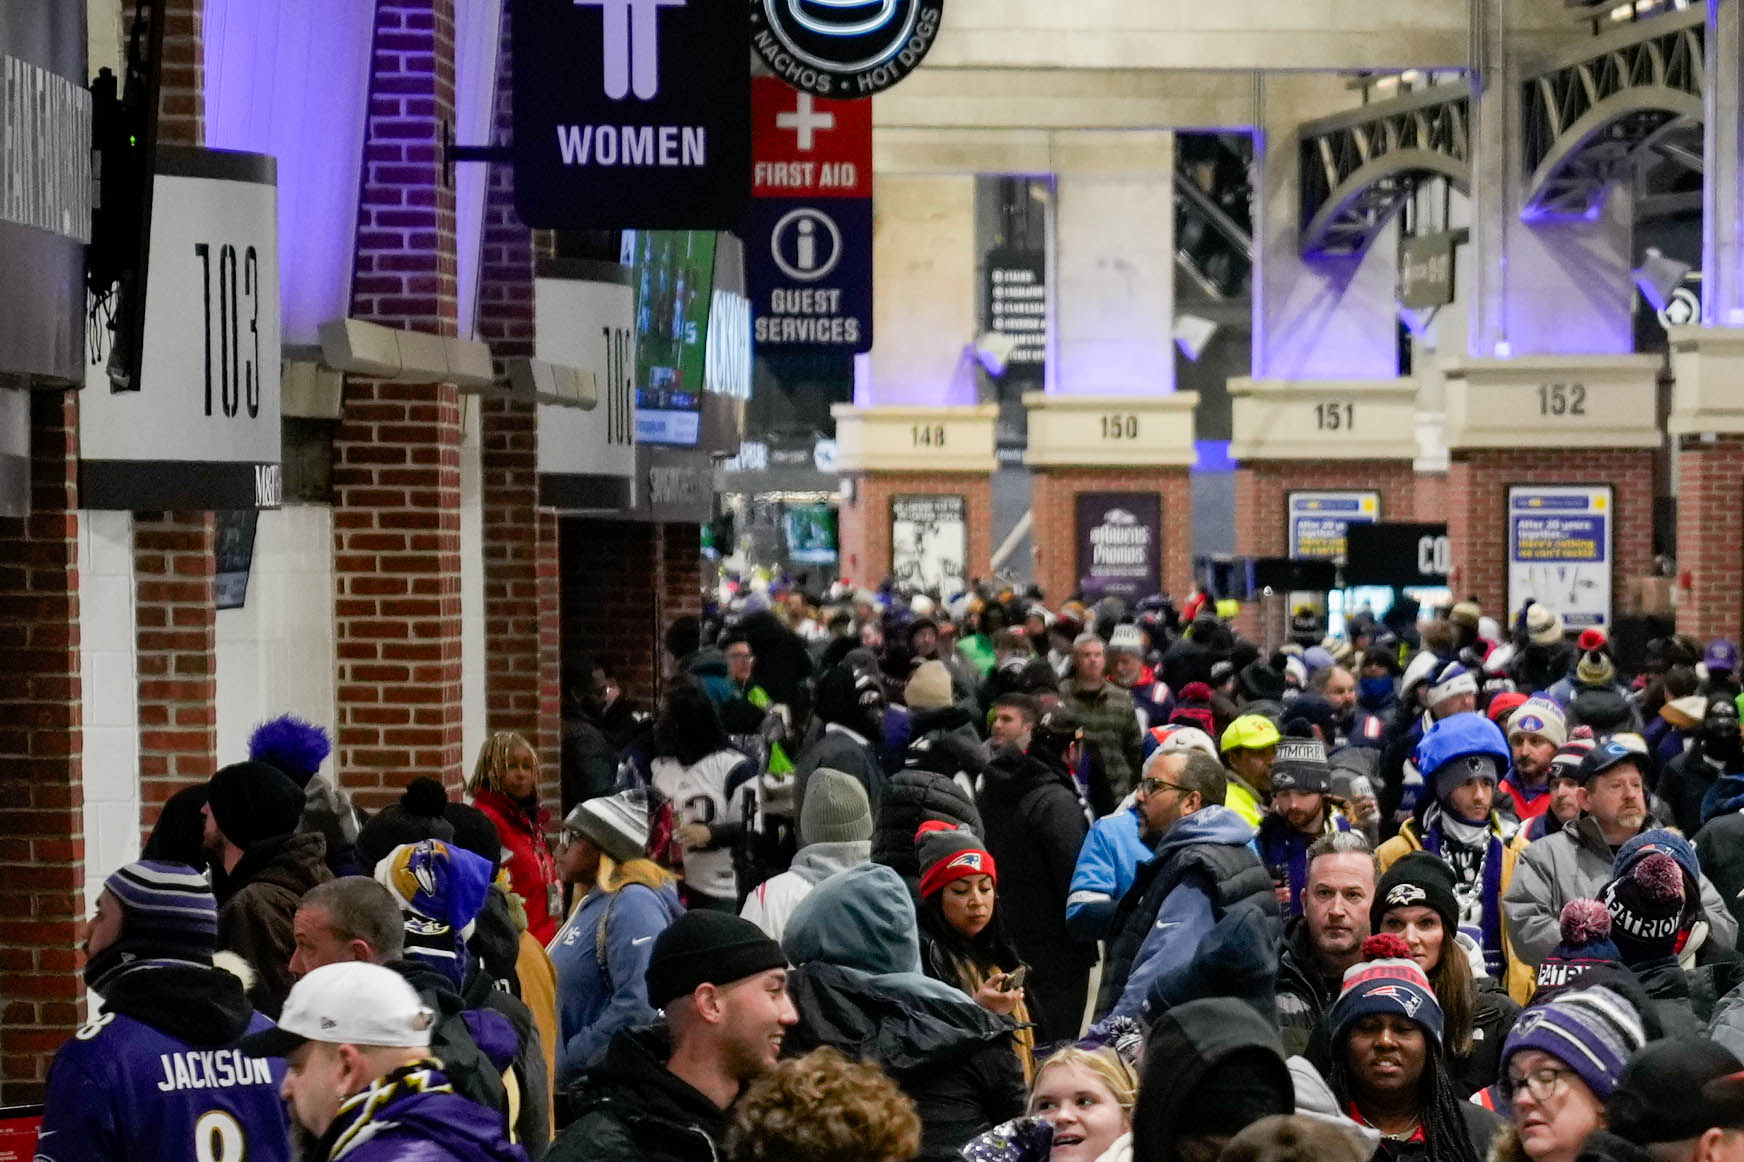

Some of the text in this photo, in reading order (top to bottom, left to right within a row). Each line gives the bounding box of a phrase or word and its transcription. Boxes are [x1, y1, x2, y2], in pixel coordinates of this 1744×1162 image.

[754, 8, 938, 92] NACHOS HOT DOGS
[557, 126, 706, 167] WOMEN
[754, 161, 856, 188] FIRST AID
[771, 288, 841, 314] GUEST
[195, 243, 260, 418] 103
[754, 316, 861, 342] SERVICES
[1537, 383, 1587, 416] 152
[1099, 415, 1138, 440] 150
[1314, 403, 1354, 430] 151
[910, 424, 945, 448] 148
[158, 1051, 273, 1092] JACKSON
